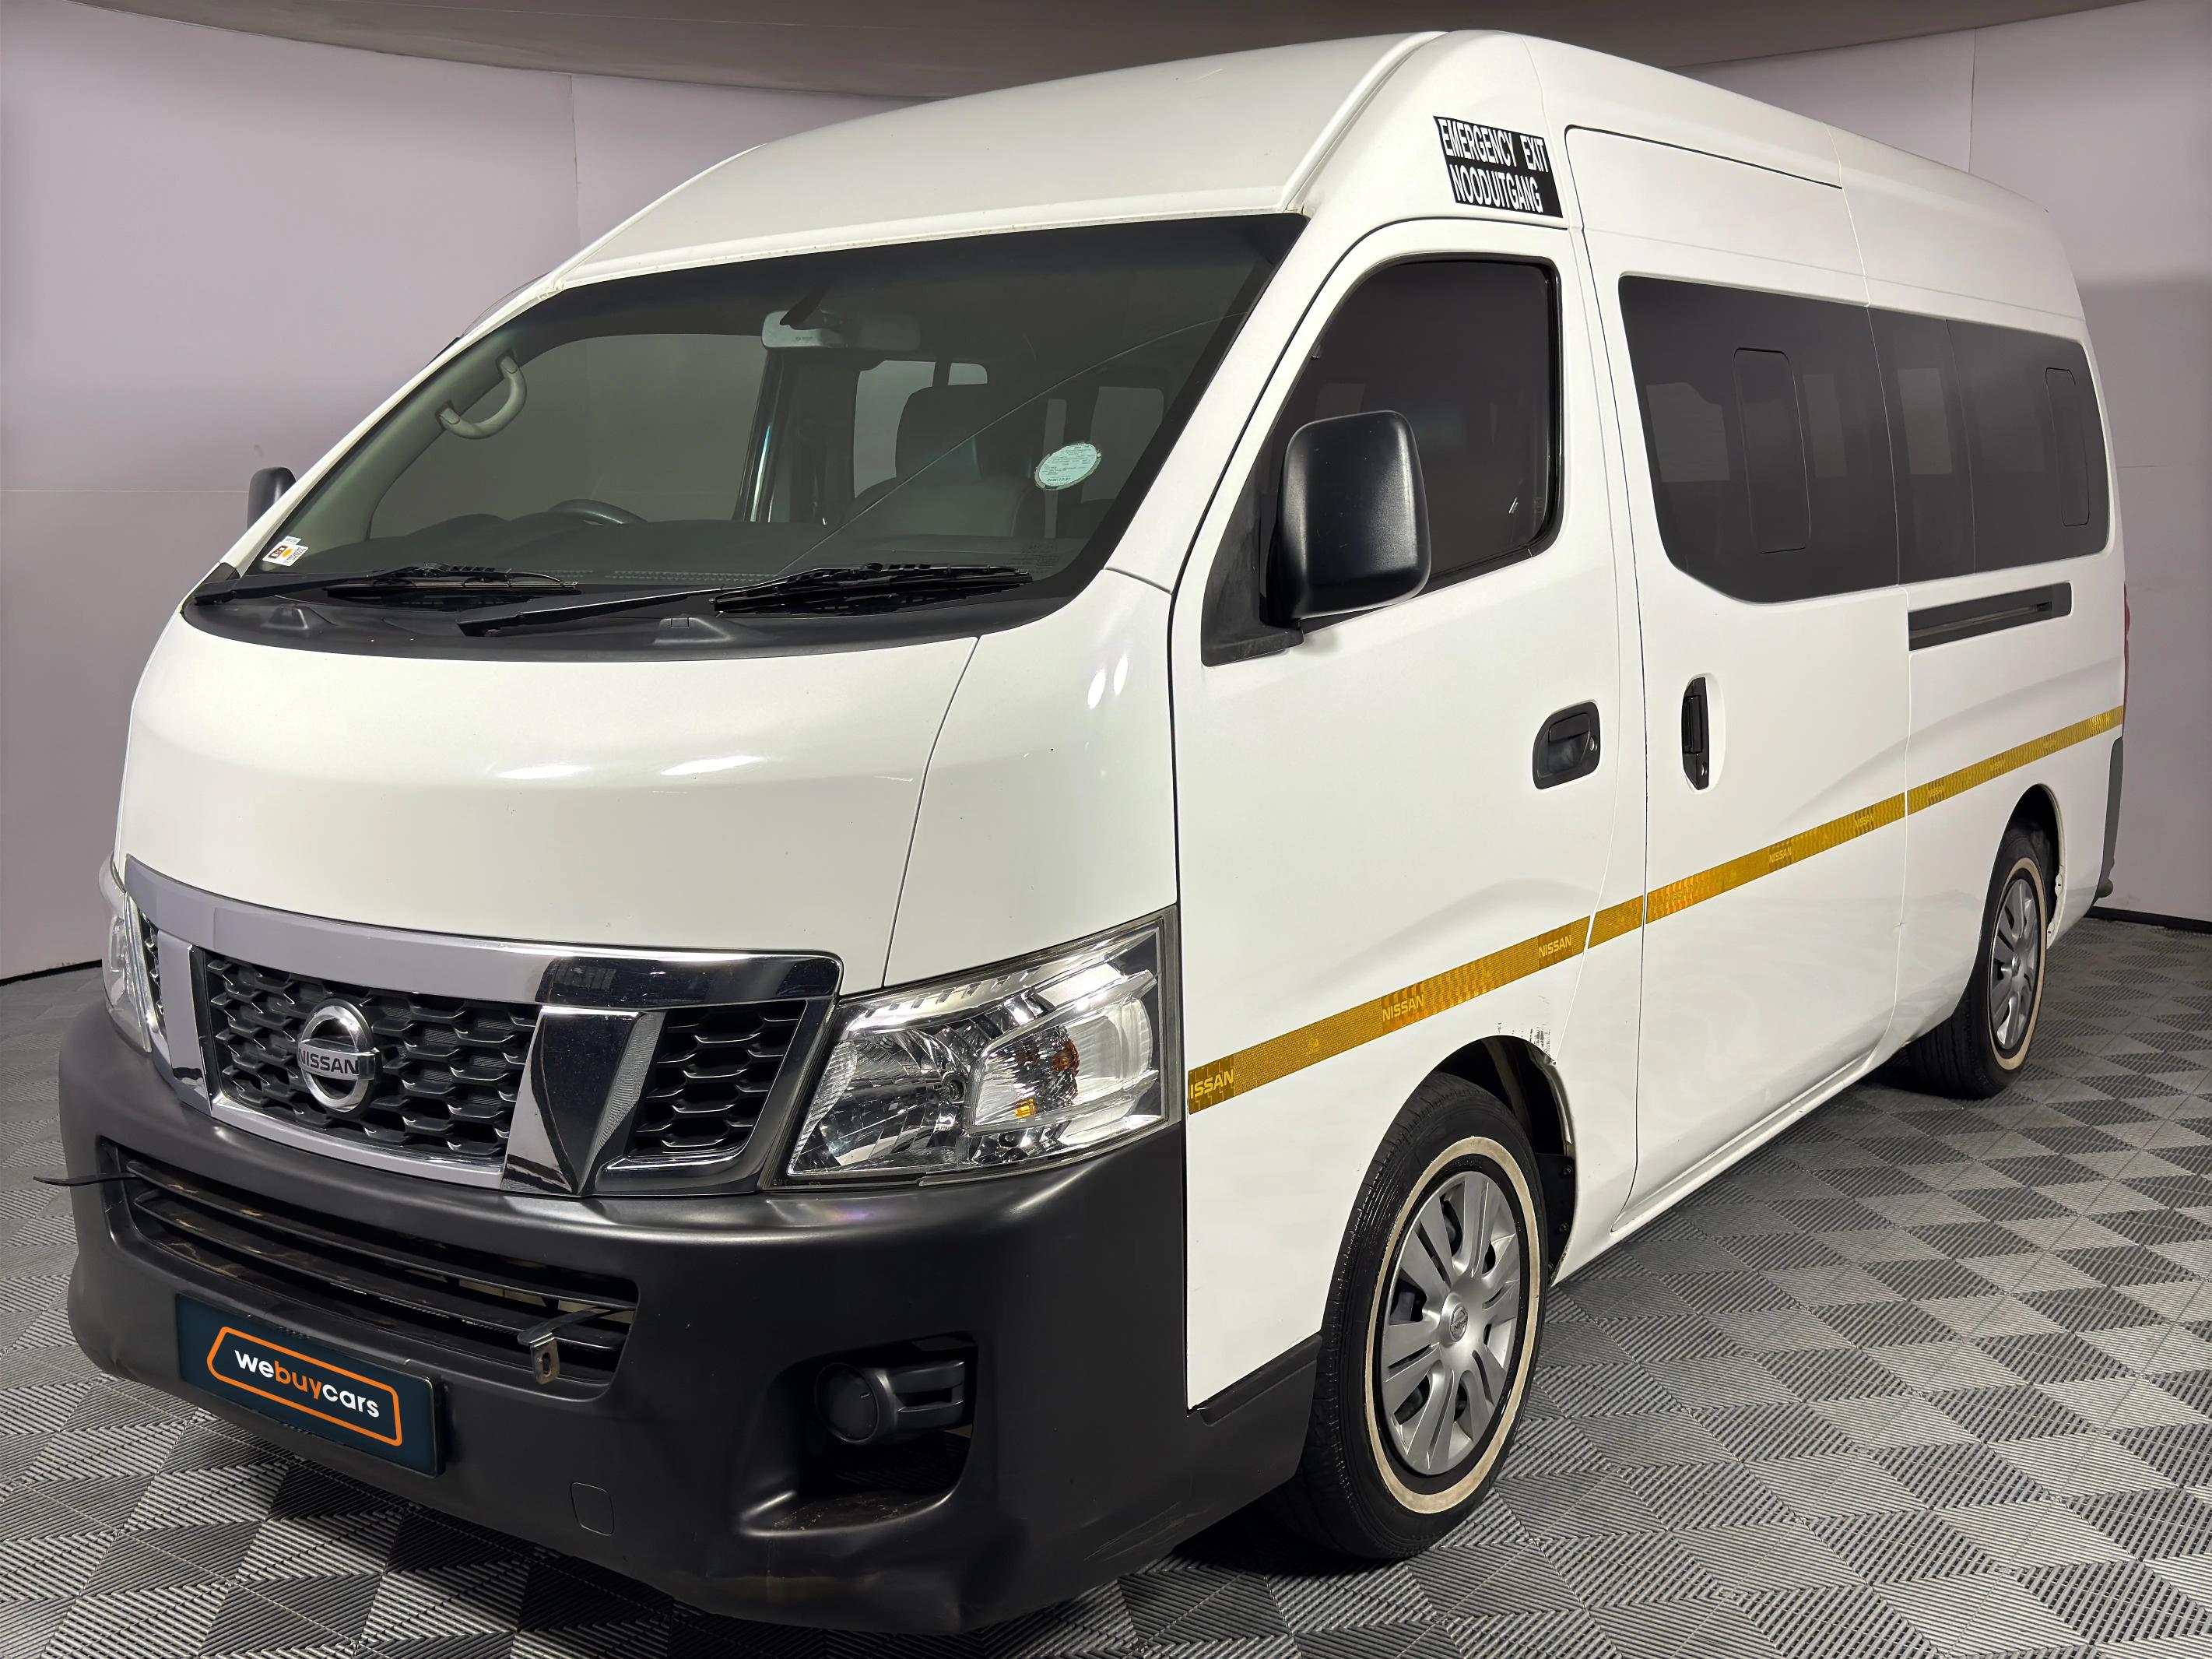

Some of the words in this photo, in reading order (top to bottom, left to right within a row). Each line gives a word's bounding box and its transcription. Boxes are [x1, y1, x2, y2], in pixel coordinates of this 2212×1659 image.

[1438, 118, 1517, 167] EMERGENCY
[1519, 135, 1549, 173] EXIT
[1449, 163, 1544, 213] NOODUITGANG
[1768, 846, 1792, 863] NISSAN
[1539, 934, 1571, 958] NISSAN
[1382, 993, 1424, 1022] NISSAN
[298, 1048, 360, 1075] NISSAN
[1189, 1069, 1234, 1099] ISSAN
[234, 1349, 380, 1418] webuycars
